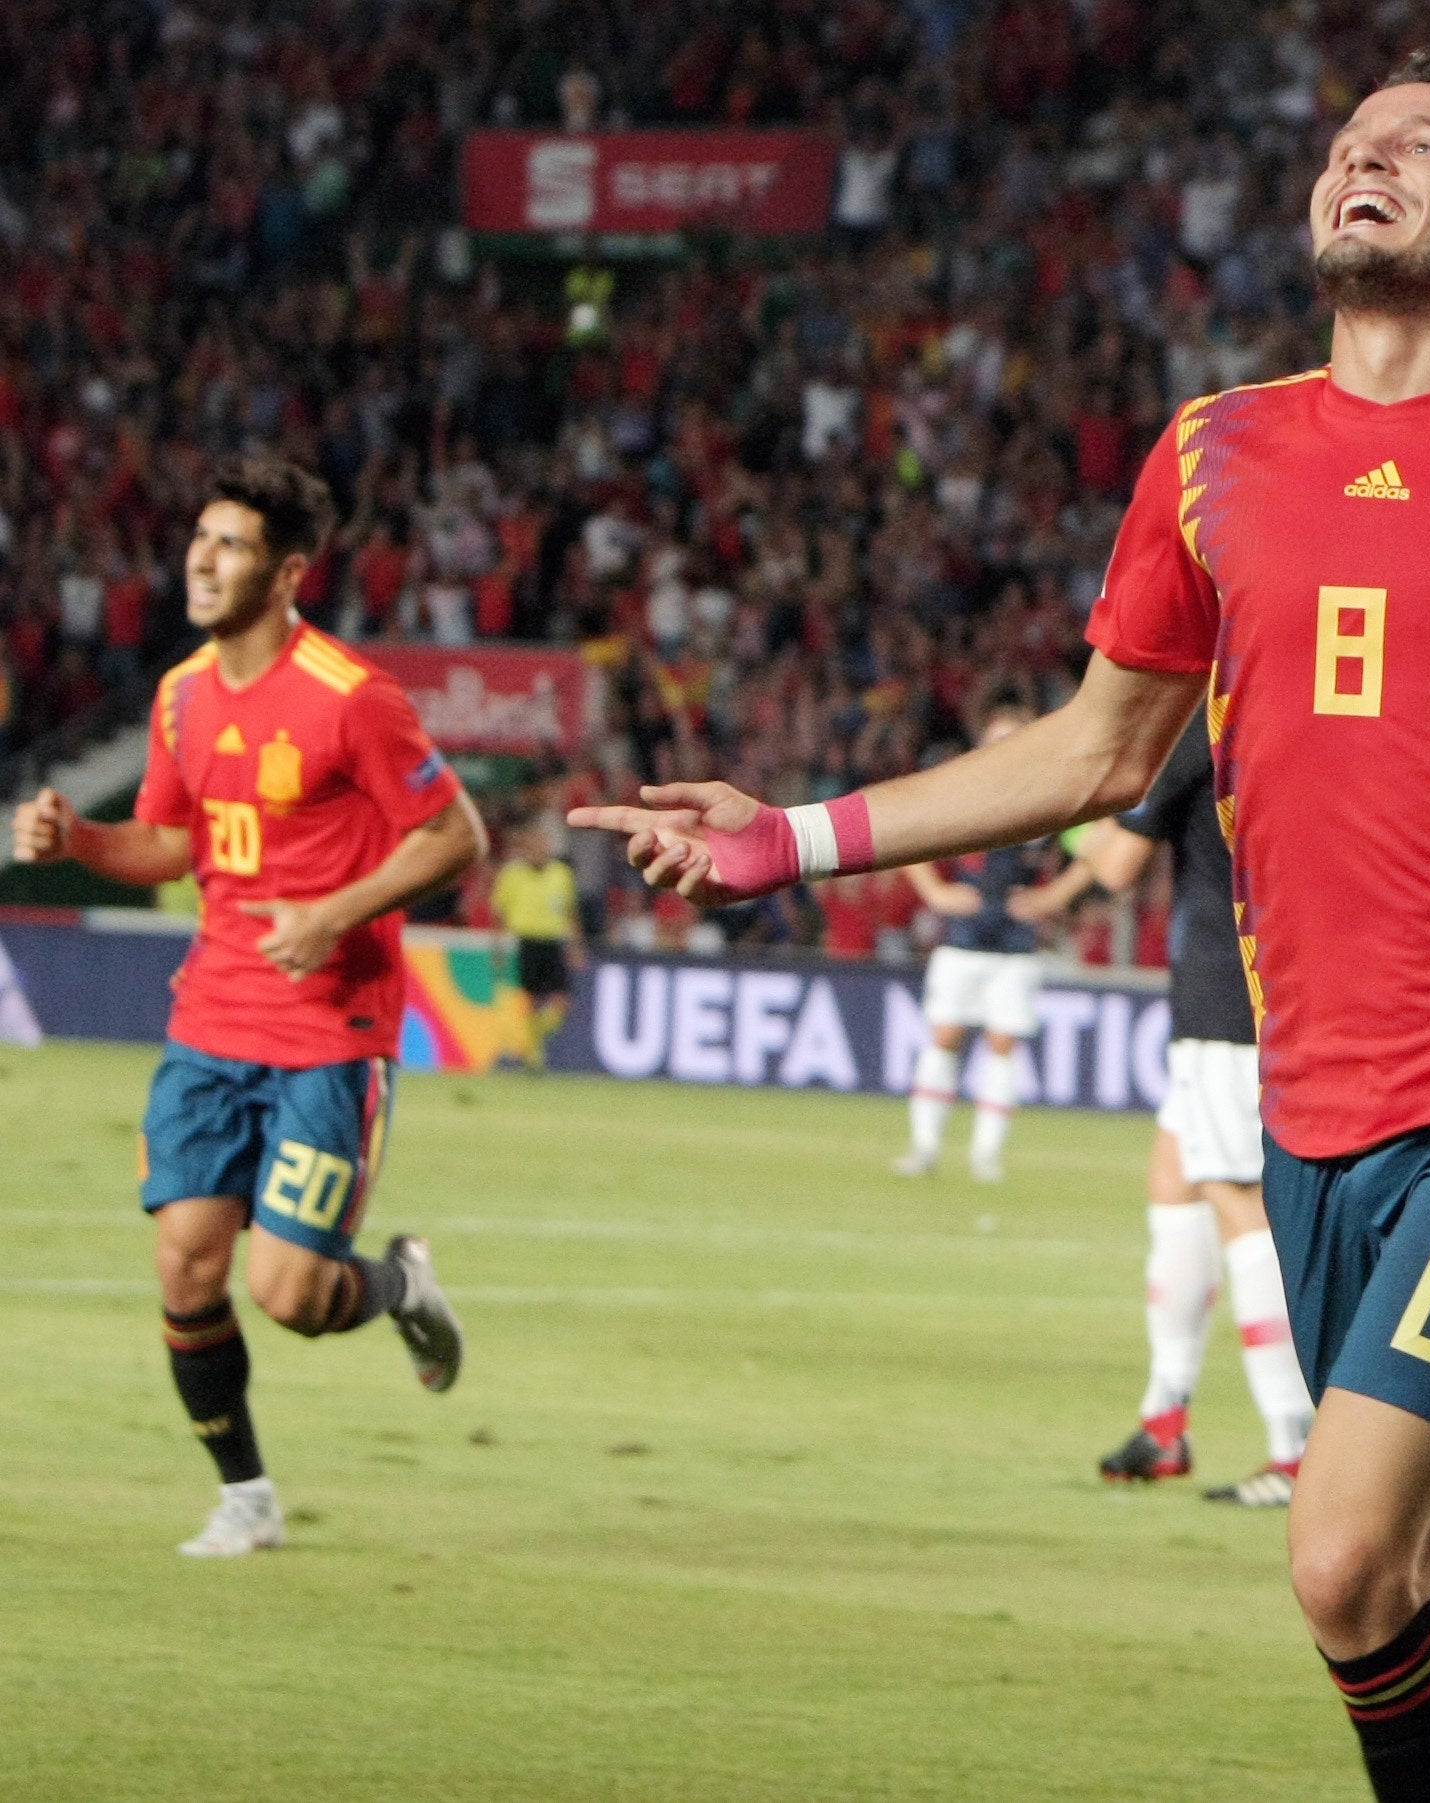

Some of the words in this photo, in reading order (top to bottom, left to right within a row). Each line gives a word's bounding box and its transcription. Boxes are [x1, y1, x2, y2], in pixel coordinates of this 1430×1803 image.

[1344, 483, 1411, 500] adidas
[1313, 585, 1388, 717] 8
[202, 797, 263, 877] 20
[596, 963, 859, 1092] UEFA
[262, 1138, 353, 1231] 20
